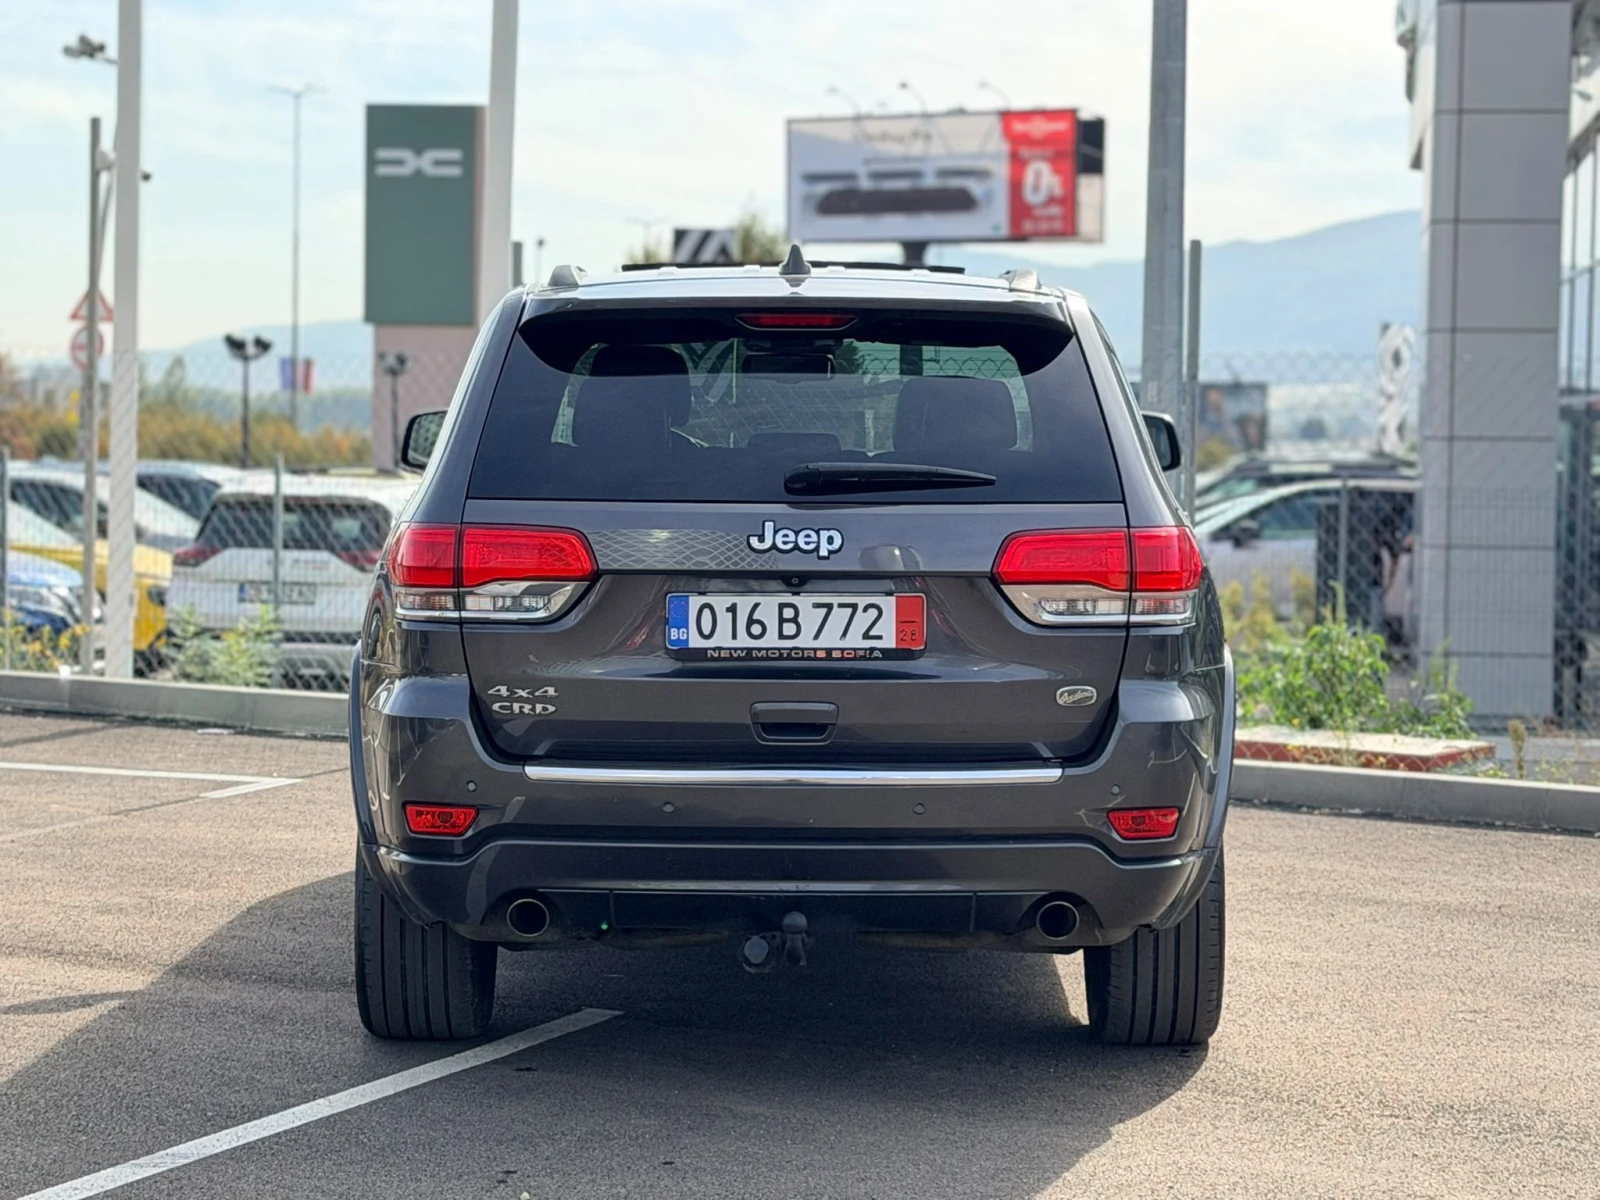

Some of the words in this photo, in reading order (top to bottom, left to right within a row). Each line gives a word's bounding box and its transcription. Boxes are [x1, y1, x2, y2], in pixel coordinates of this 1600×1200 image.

[748, 520, 843, 558] Jeep
[695, 602, 883, 640] 016B772
[670, 628, 687, 640] BG
[899, 629, 917, 641] 28
[752, 650, 826, 658] MOTORS
[831, 650, 883, 658] SOFIA
[487, 685, 559, 698] 4x4
[491, 702, 556, 715] CRD
